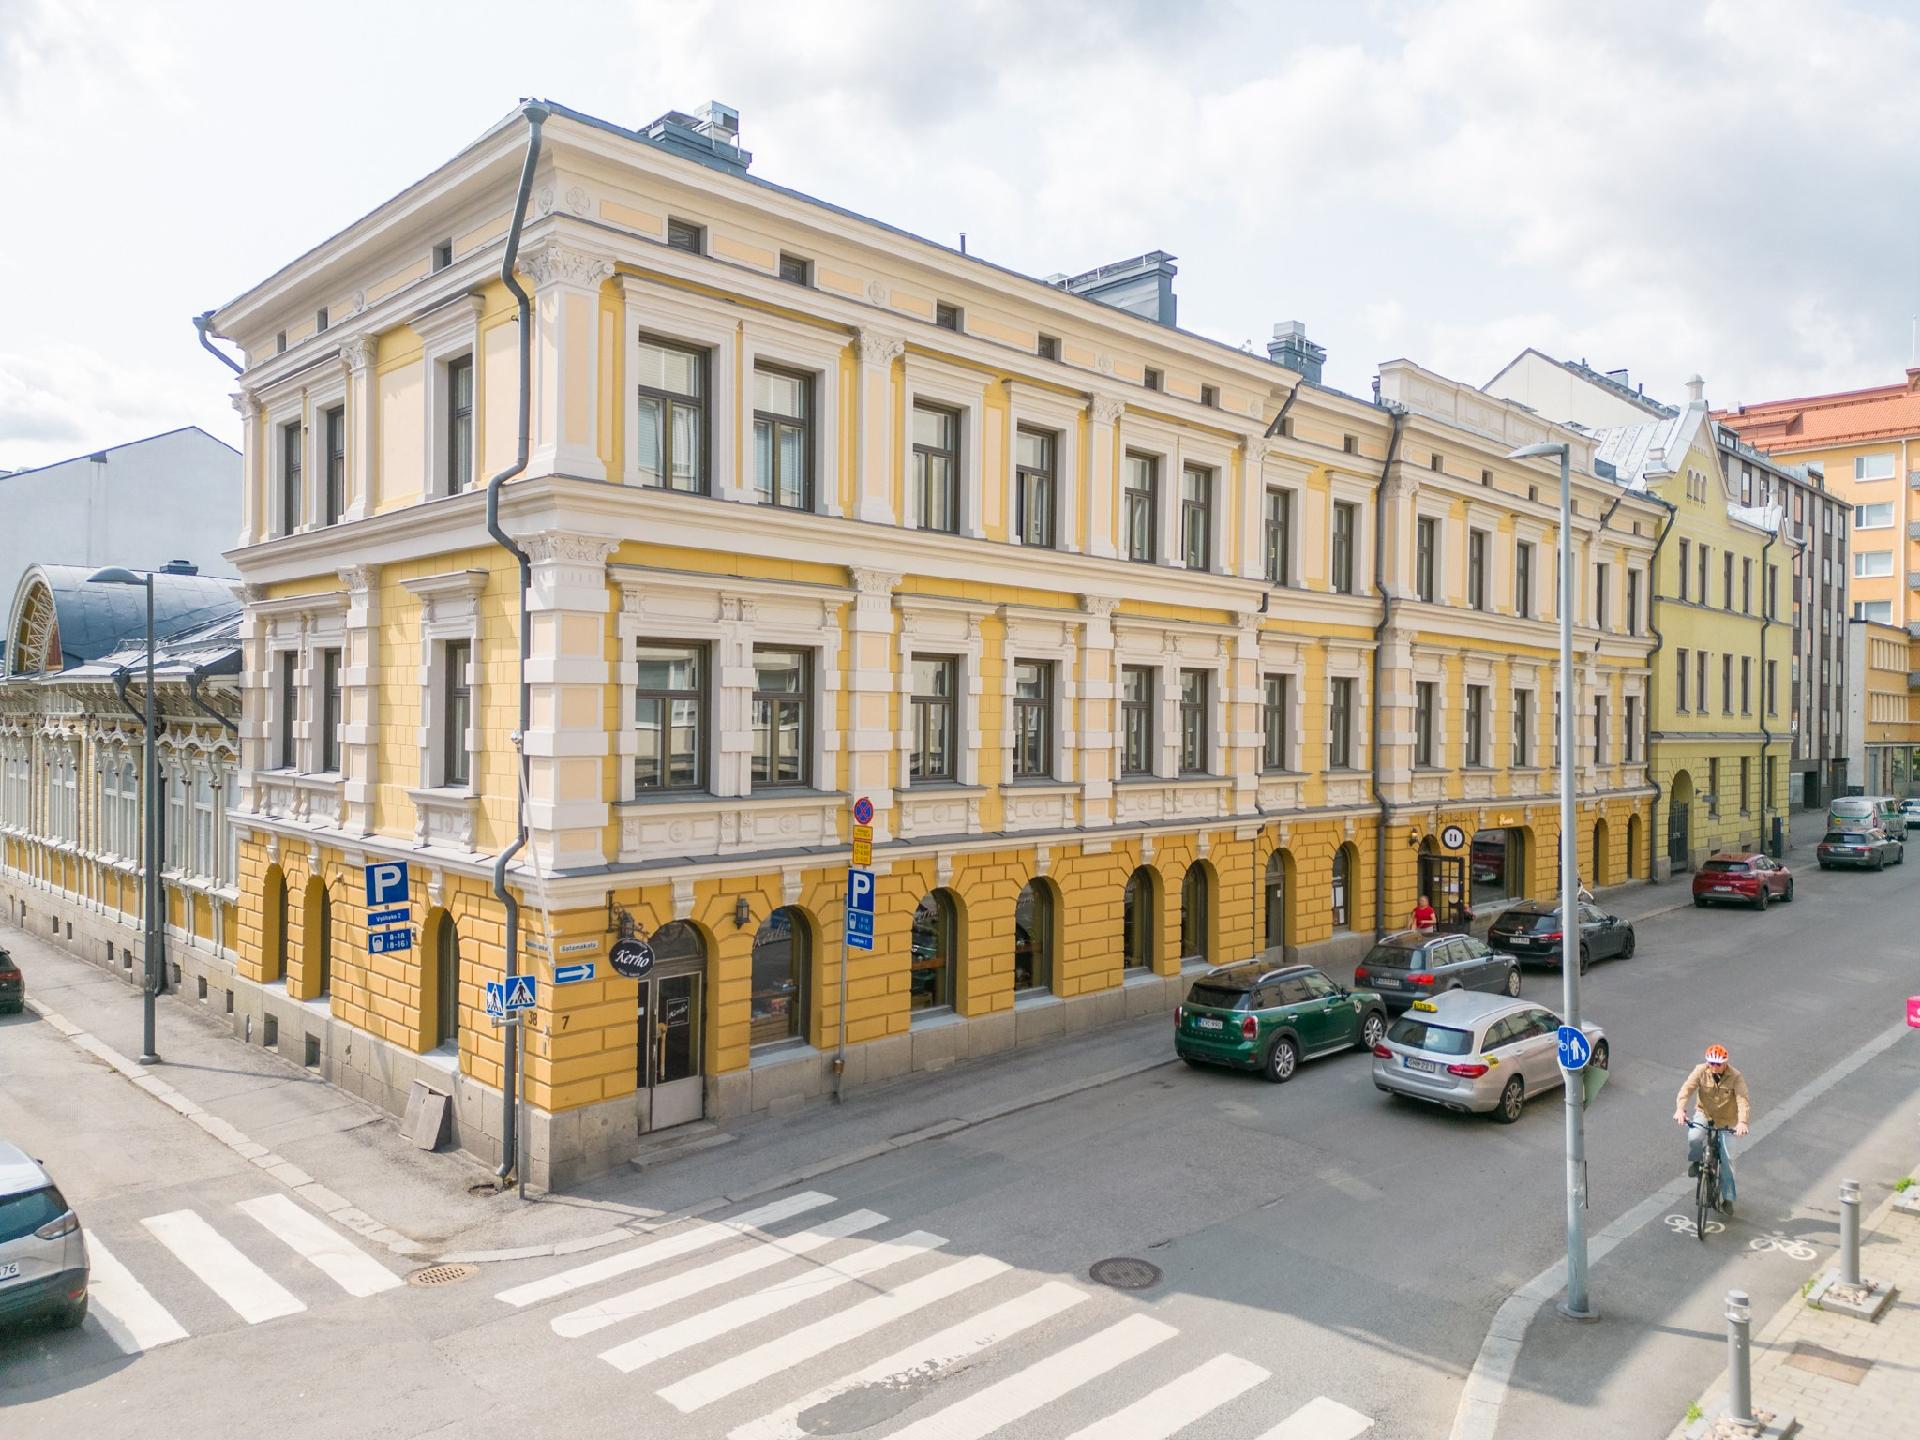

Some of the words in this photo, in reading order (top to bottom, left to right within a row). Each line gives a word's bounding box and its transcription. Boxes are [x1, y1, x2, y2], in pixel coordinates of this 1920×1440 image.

[374, 865, 401, 903] P
[852, 872, 870, 908] P
[614, 949, 650, 968] Kerho
[528, 1010, 538, 1026] 38
[562, 1015, 570, 1030] 7
